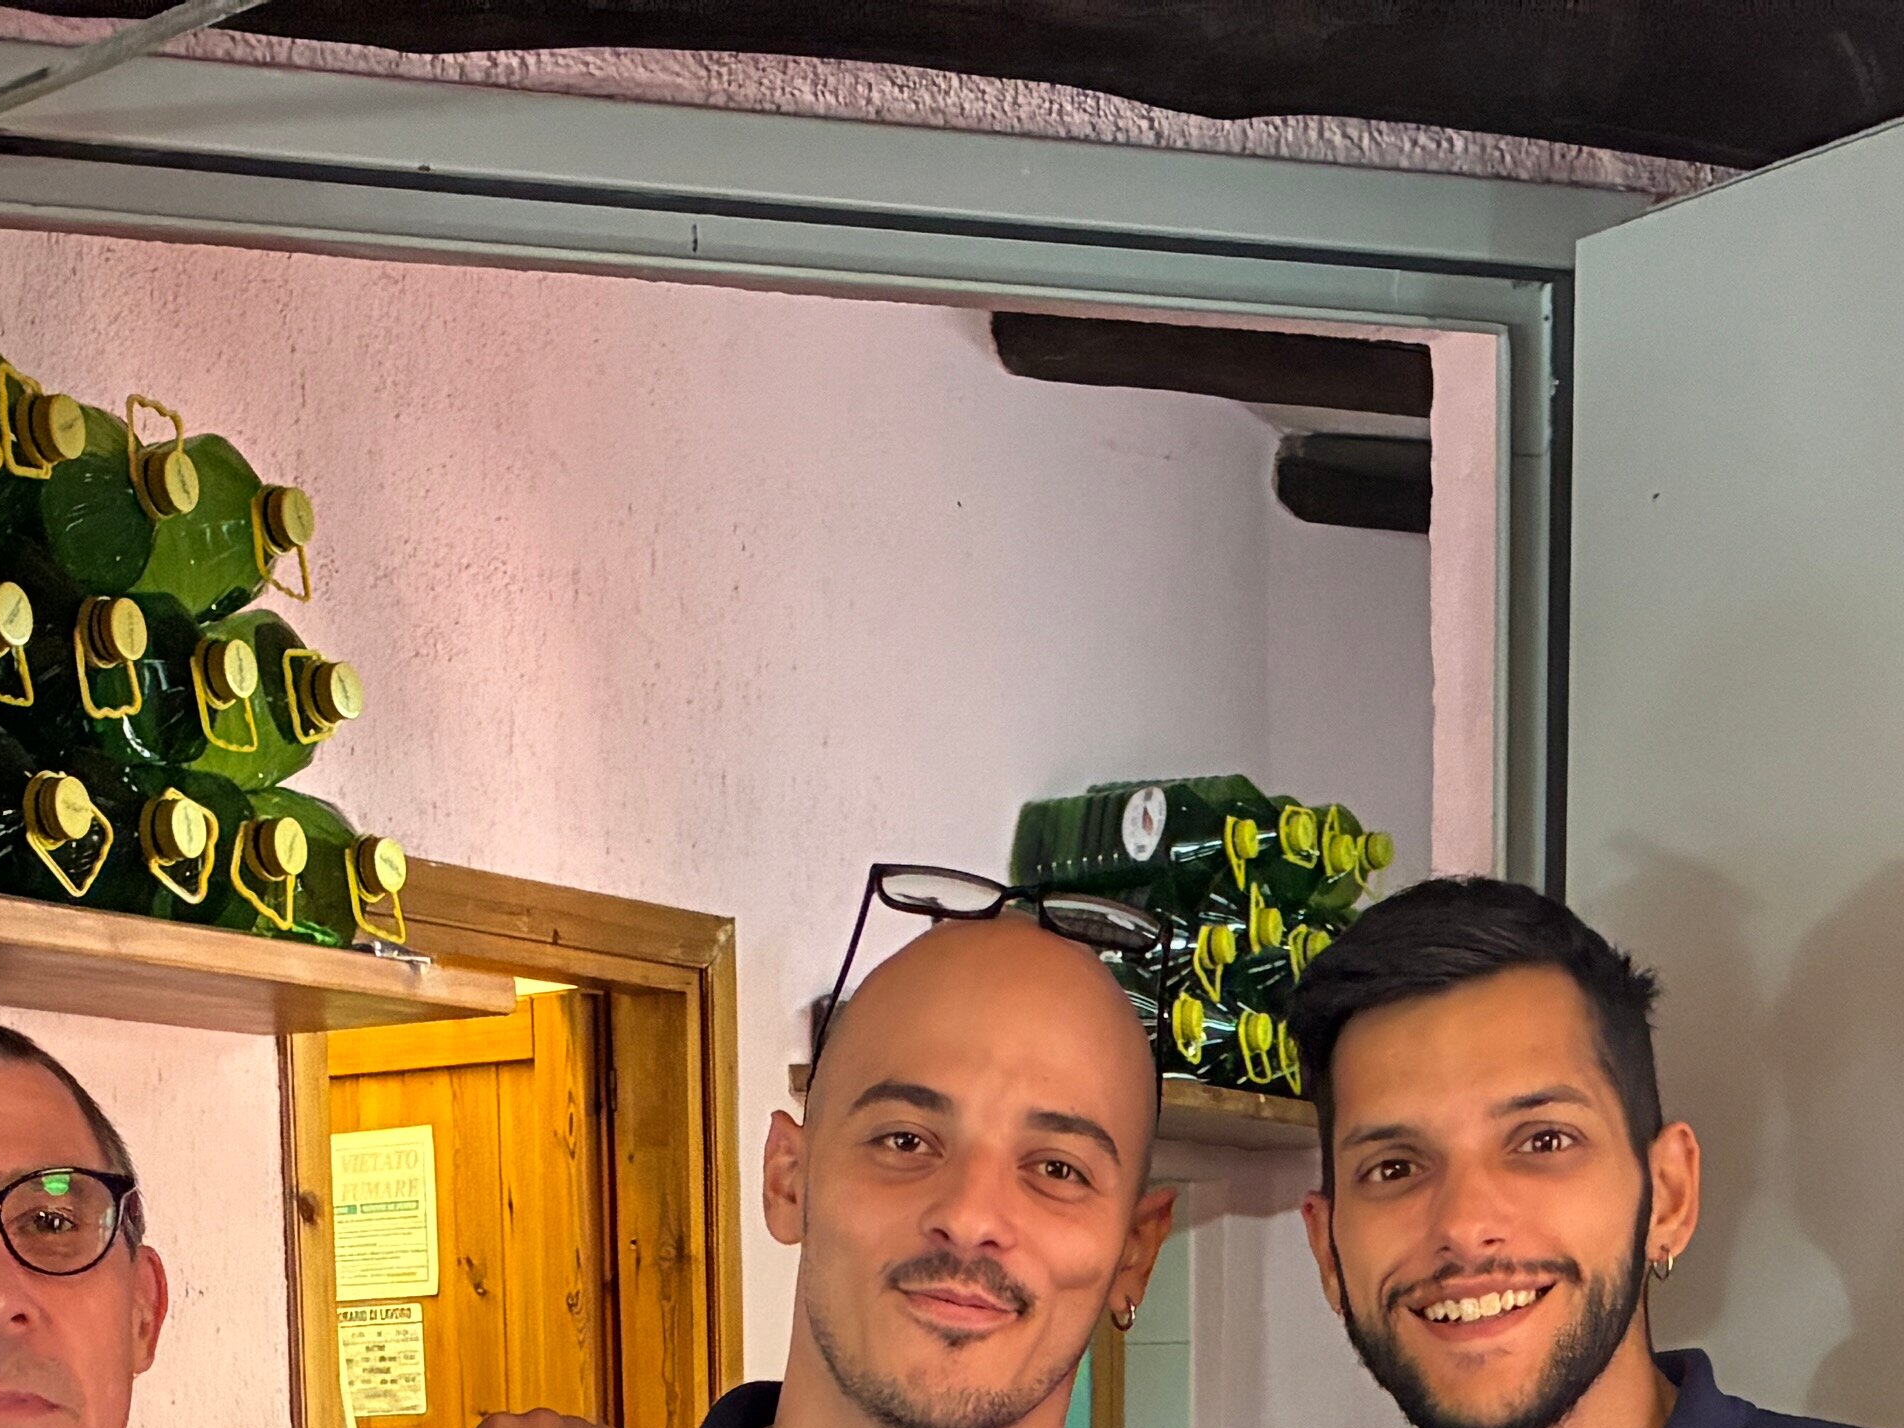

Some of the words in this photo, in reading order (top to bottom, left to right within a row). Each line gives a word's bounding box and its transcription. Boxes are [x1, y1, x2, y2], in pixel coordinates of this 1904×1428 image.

[341, 1149, 418, 1173] VIETATO
[341, 1177, 419, 1202] FUMARE
[339, 1310, 367, 1322] RARIO
